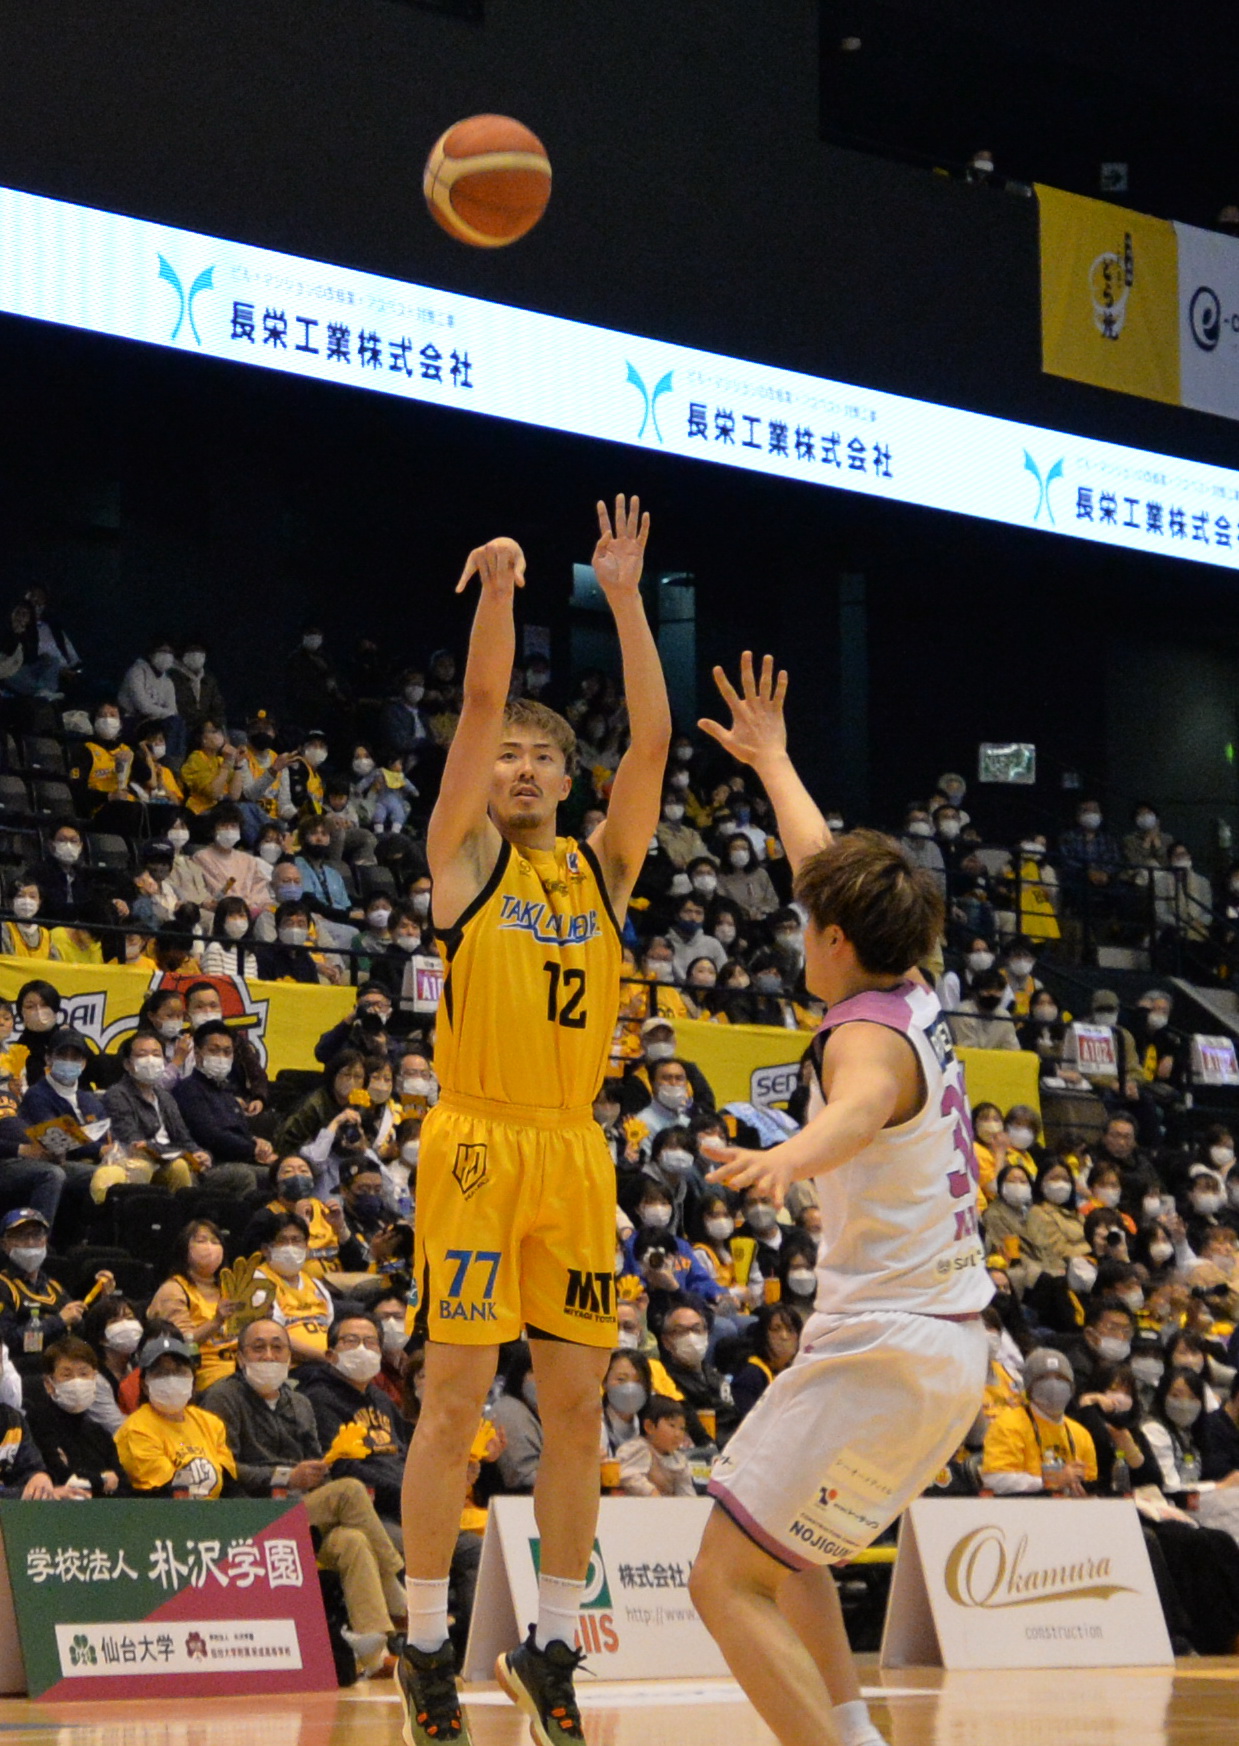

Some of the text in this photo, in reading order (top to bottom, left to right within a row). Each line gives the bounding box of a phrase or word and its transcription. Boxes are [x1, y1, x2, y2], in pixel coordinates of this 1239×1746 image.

[231, 300, 474, 388] 長栄工業株式会社
[687, 402, 894, 478] 長栄工業株式会社
[1076, 486, 1239, 549] 長栄工業株式会
[543, 960, 587, 1029] 12
[444, 1249, 502, 1300] 77
[439, 1300, 498, 1321] BANK
[27, 1539, 304, 1590] 学校法人 朴沢学園
[944, 1524, 1112, 1610] Okamura
[101, 1634, 176, 1664] 仙台大学
[1025, 1626, 1104, 1641] construction
